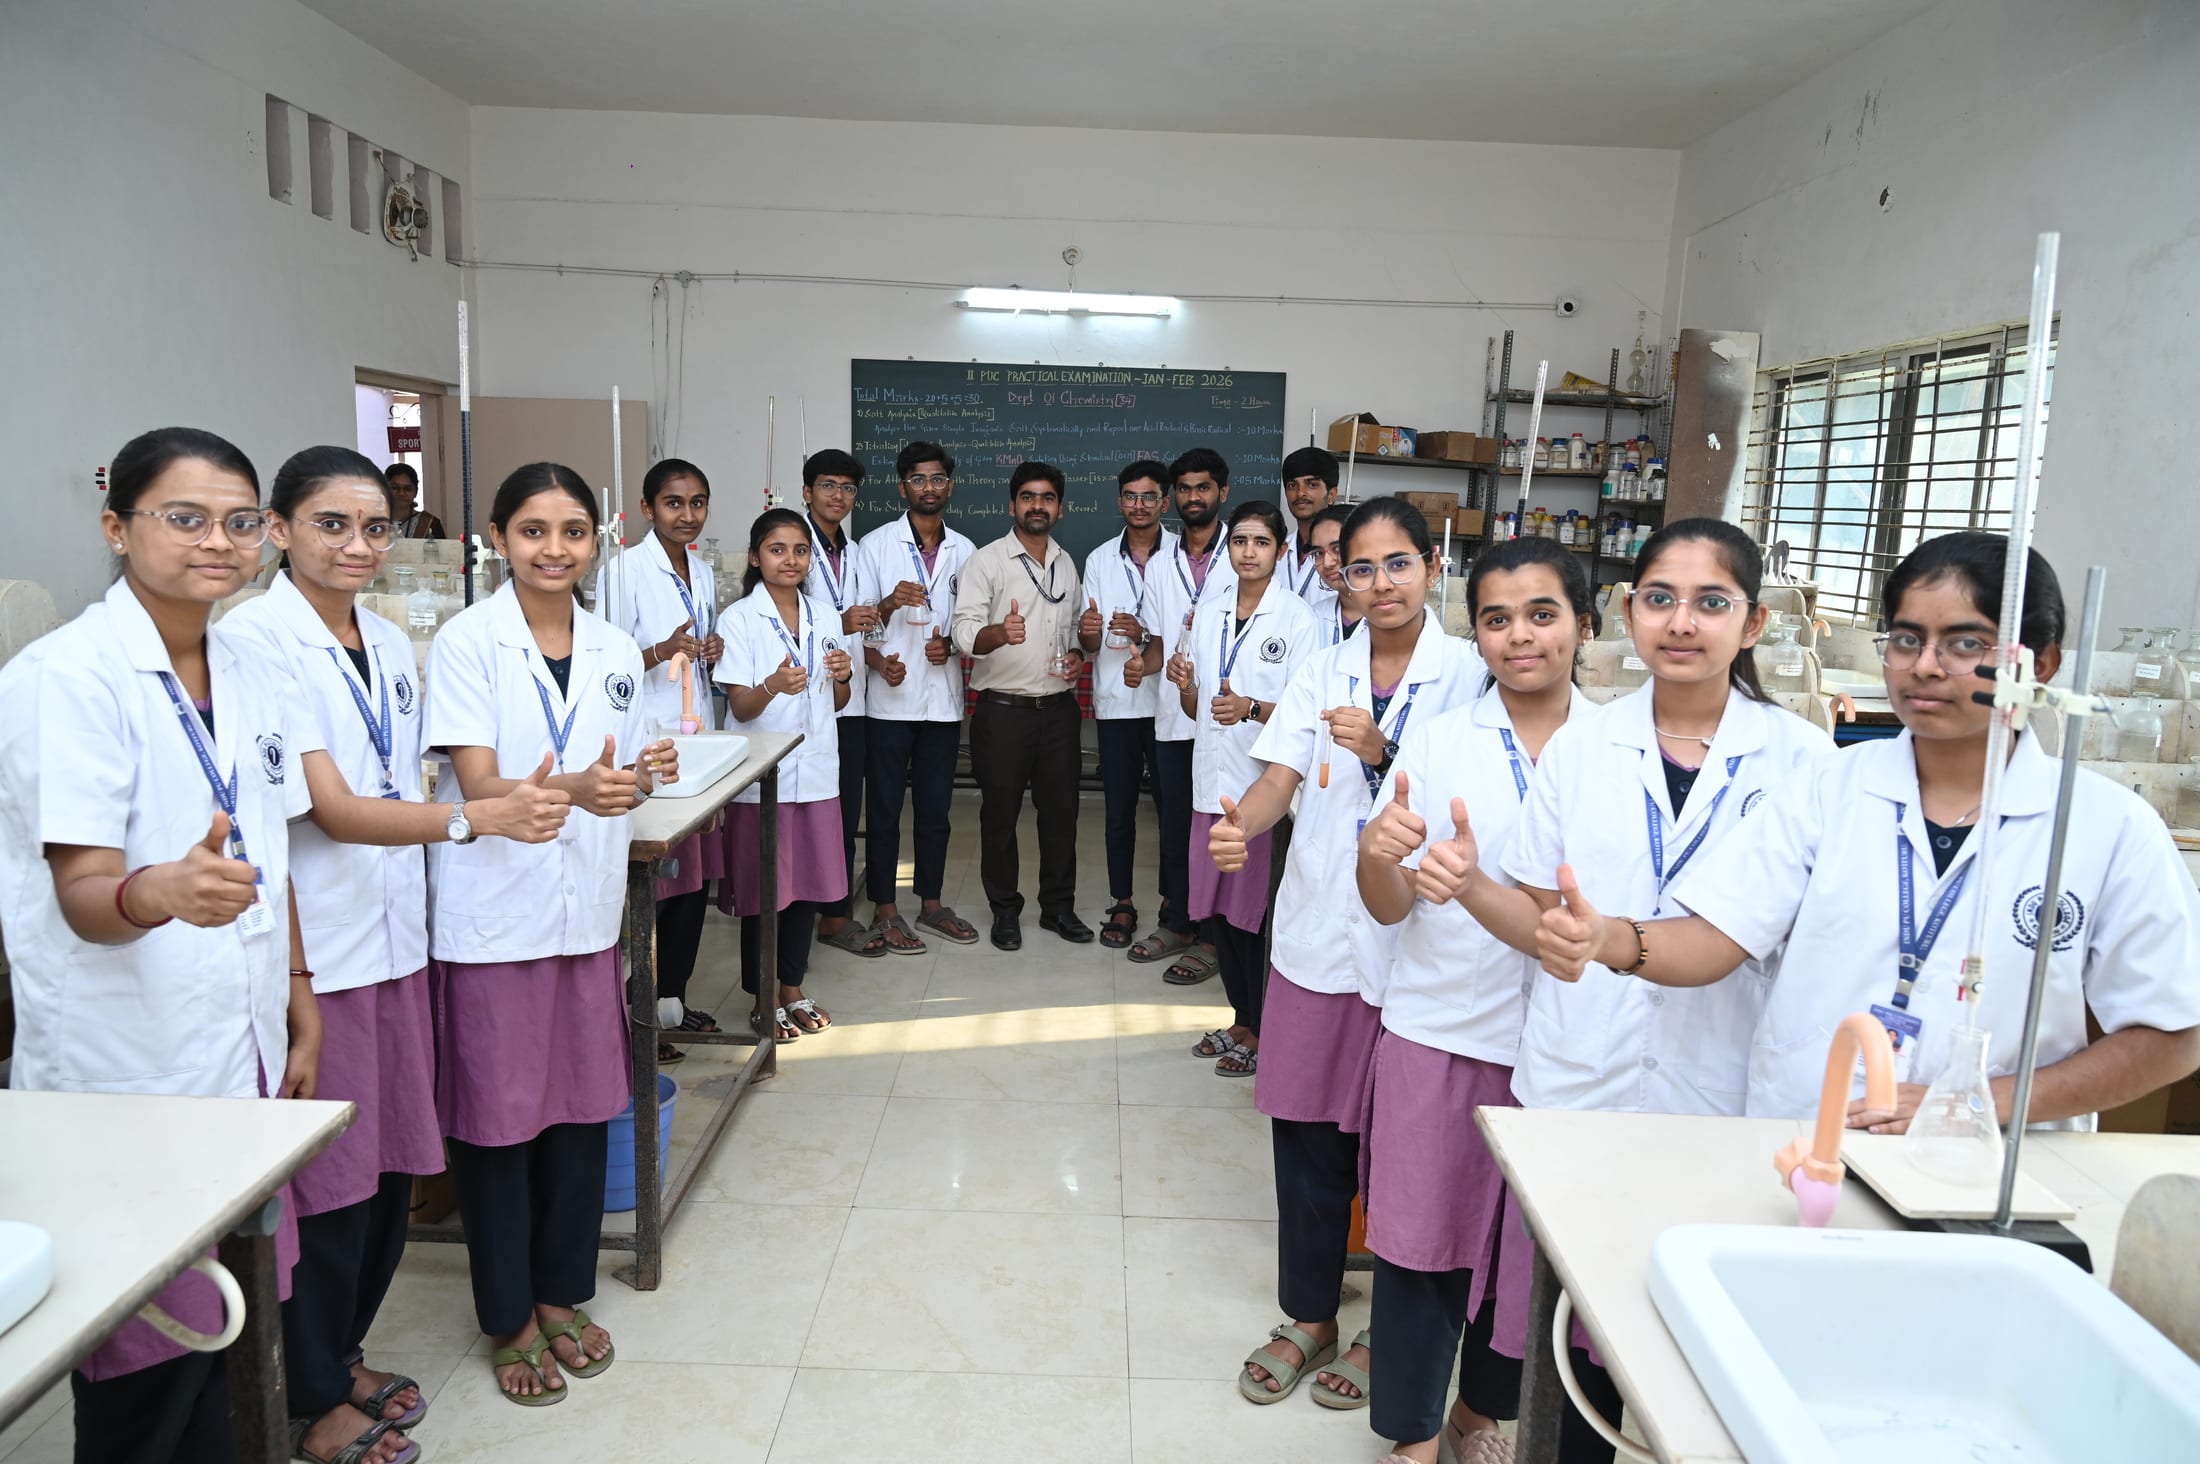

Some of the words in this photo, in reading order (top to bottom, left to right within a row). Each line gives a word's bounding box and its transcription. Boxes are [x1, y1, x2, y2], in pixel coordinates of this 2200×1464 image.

[980, 370, 1000, 382] PUC
[1007, 370, 1059, 383] PRACTICAL
[1200, 374, 1233, 387] 2026
[853, 386, 879, 400] Total
[1008, 388, 1034, 407] Dept
[398, 438, 420, 448] SPOR
[1137, 450, 1159, 462] FAS
[968, 473, 995, 488] Theory
[869, 500, 882, 512] For
[1902, 913, 1909, 923] PU
[1902, 924, 1910, 944] INDU
